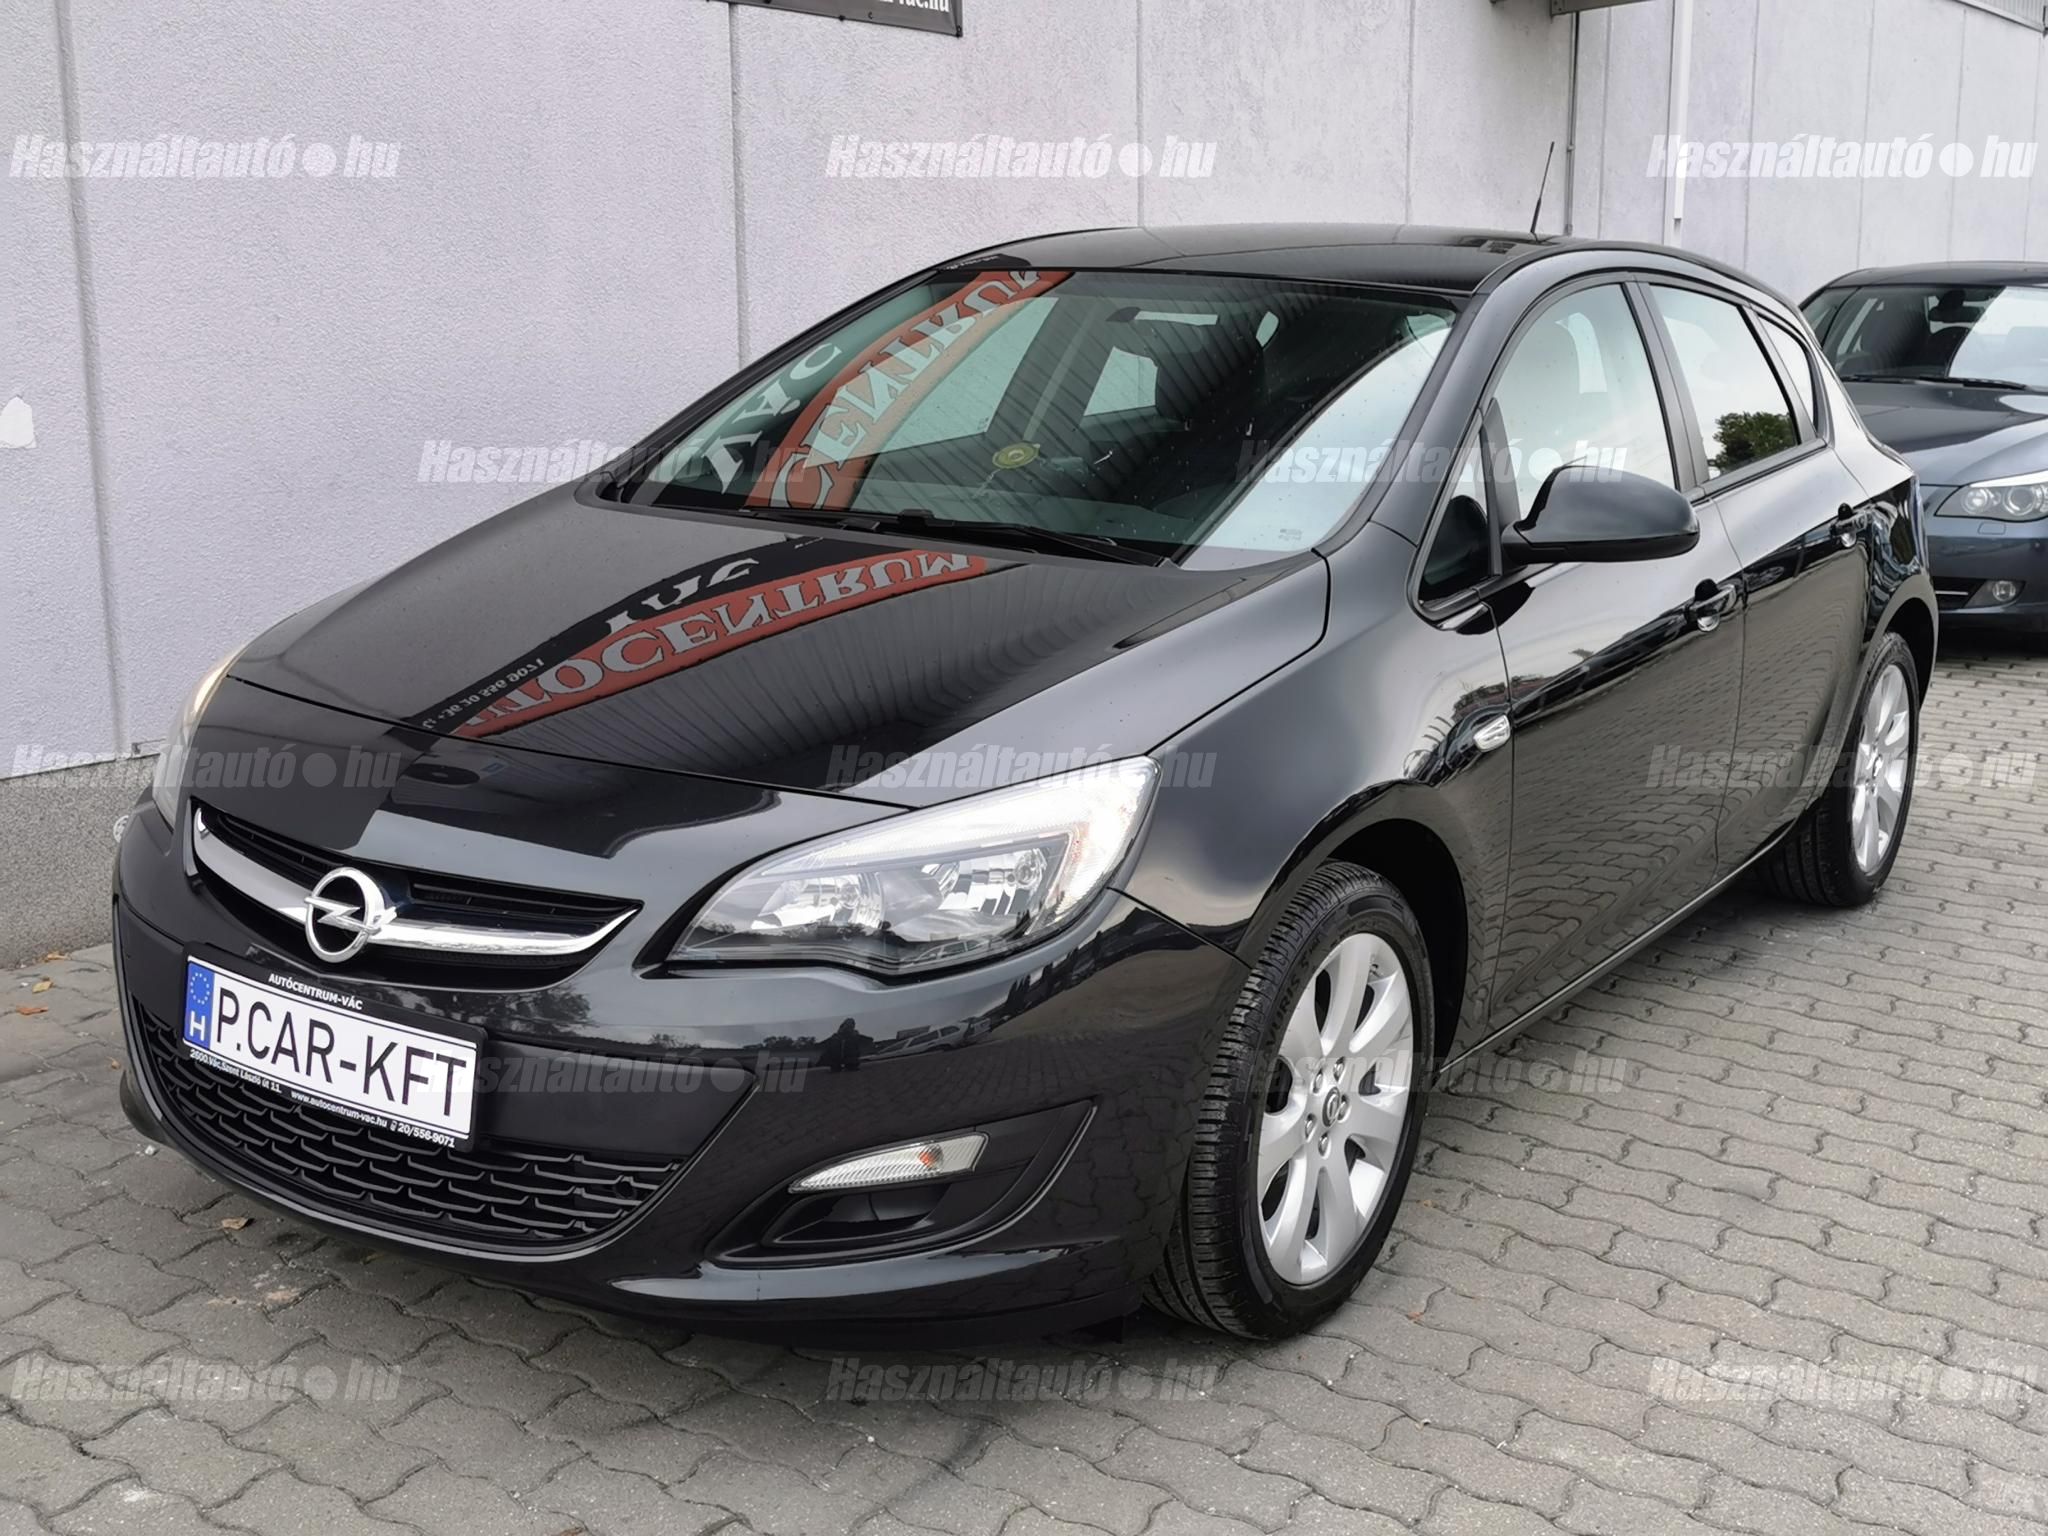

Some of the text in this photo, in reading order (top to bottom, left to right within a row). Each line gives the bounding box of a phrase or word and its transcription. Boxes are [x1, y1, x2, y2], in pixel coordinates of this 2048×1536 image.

[268, 973, 363, 1010] AUTÓCENTRUM-VÁC
[189, 1011, 205, 1041] H
[217, 987, 467, 1117] P.CAR-KFT
